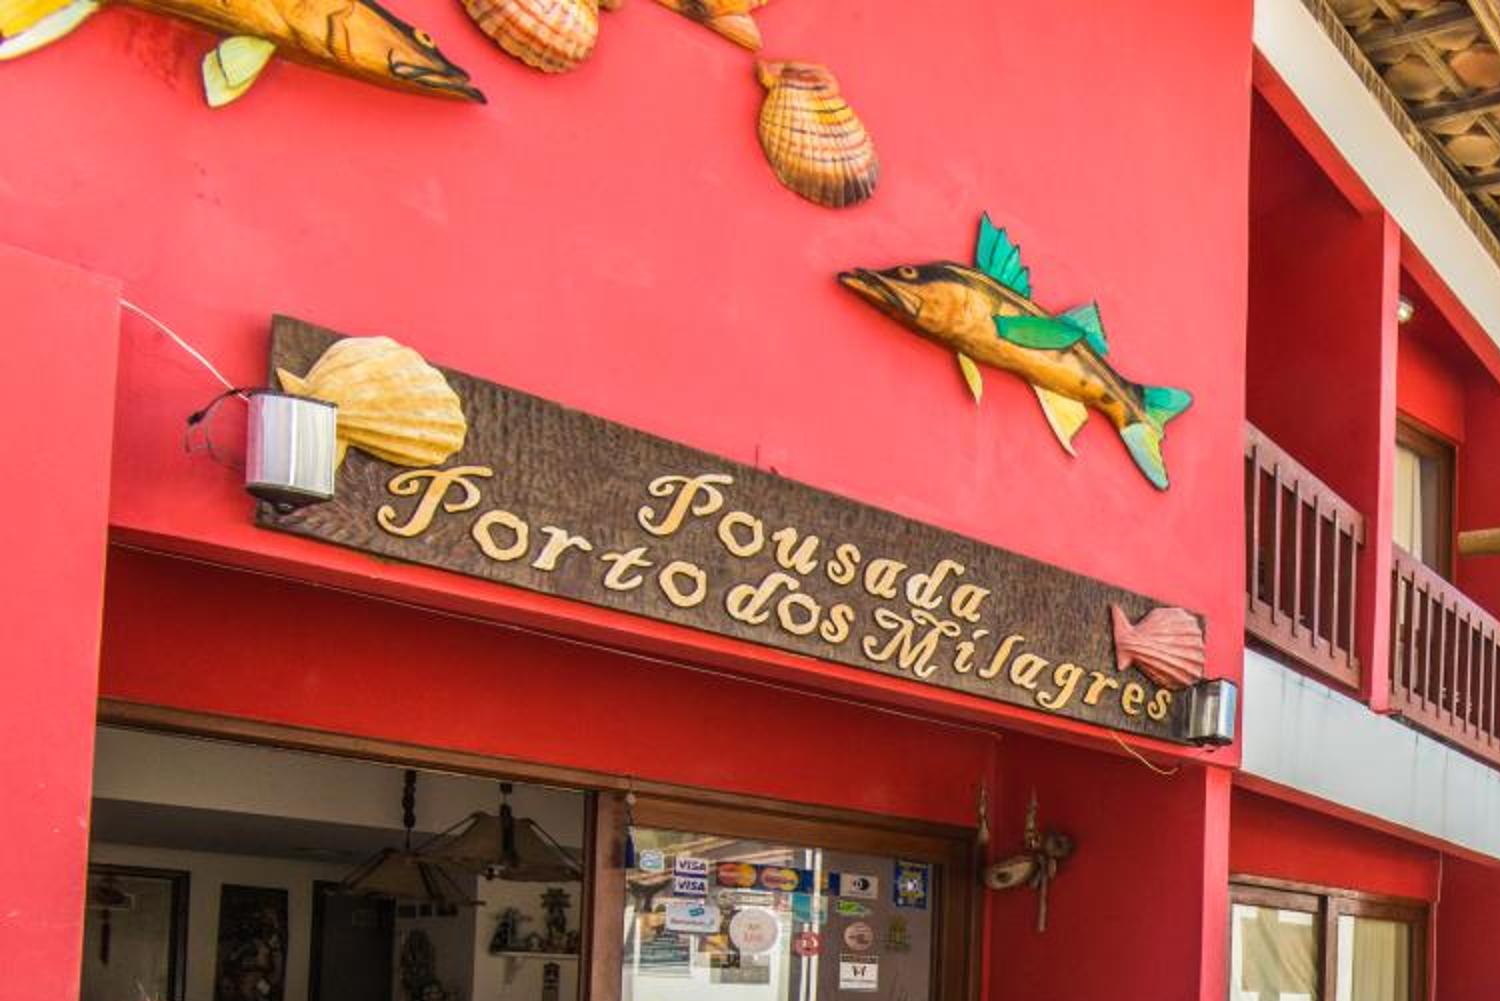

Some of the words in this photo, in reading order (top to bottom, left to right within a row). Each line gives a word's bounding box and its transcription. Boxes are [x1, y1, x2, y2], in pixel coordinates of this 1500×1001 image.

[376, 465, 707, 608] Porto
[725, 571, 855, 643] dos
[638, 473, 991, 622] Pousada
[679, 860, 707, 870] VISA
[679, 880, 705, 891] VISA
